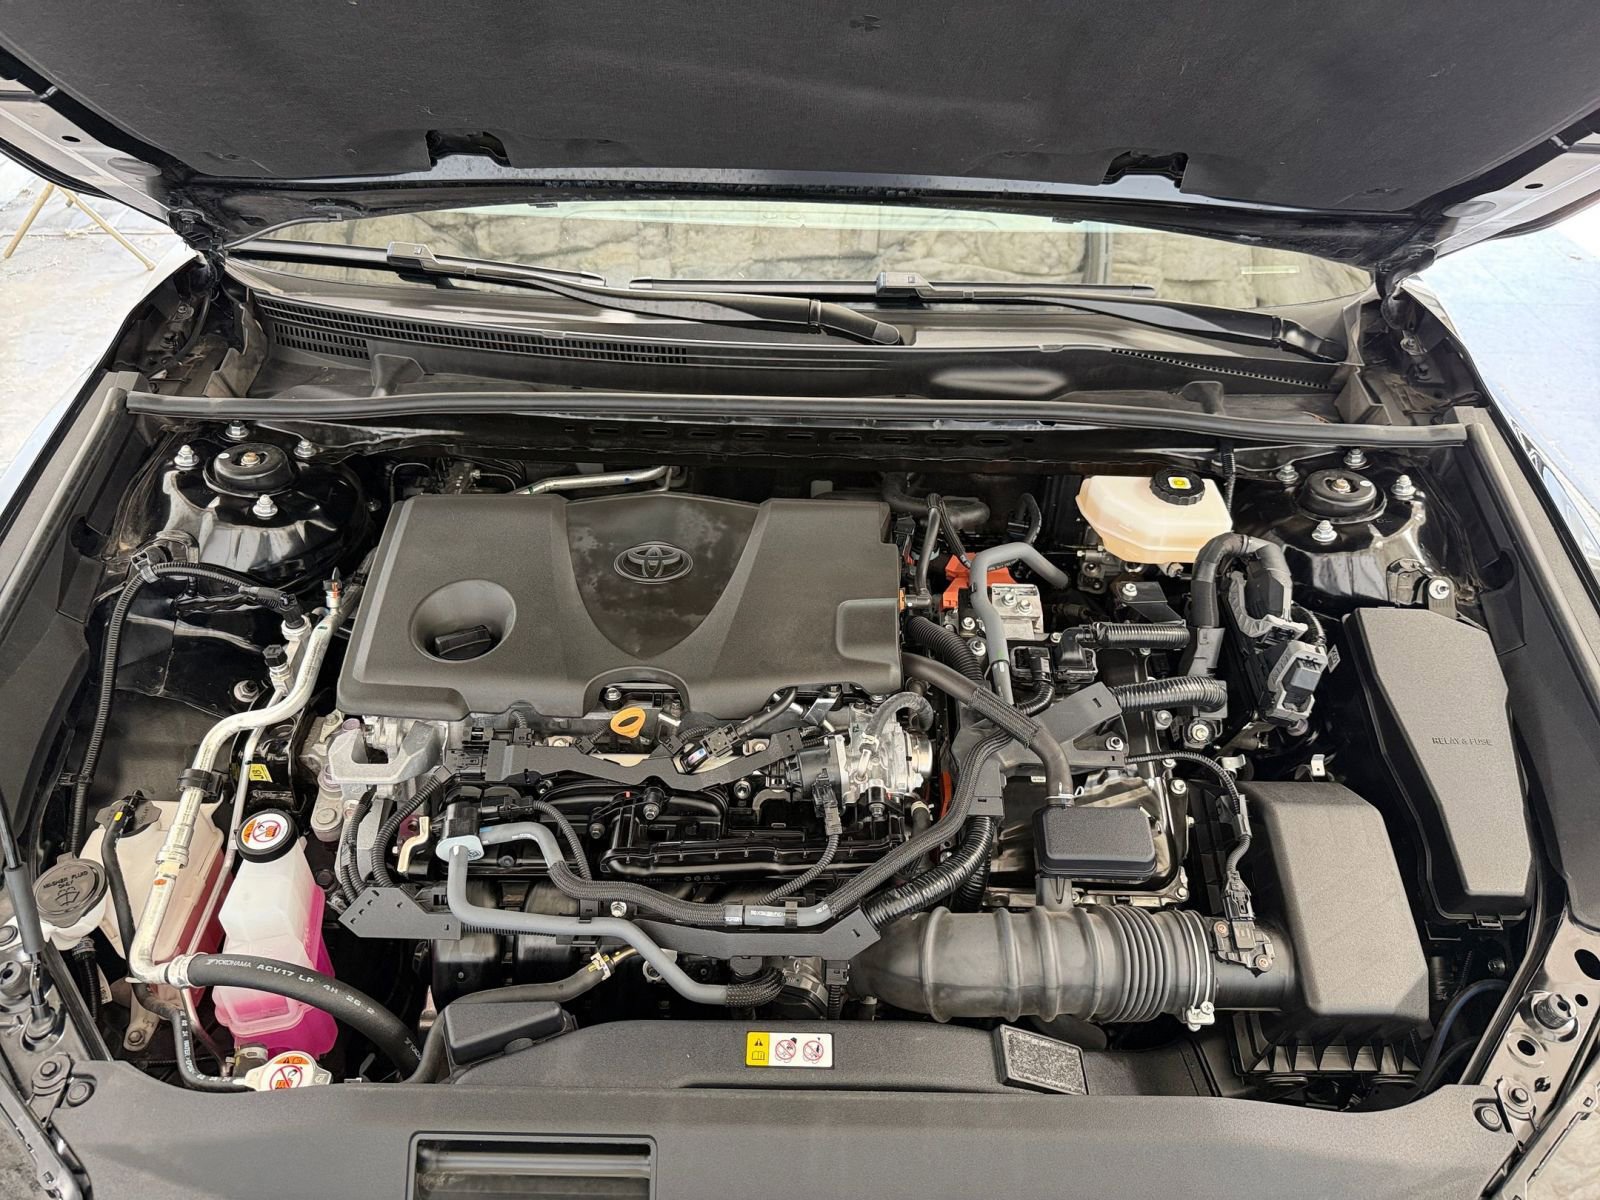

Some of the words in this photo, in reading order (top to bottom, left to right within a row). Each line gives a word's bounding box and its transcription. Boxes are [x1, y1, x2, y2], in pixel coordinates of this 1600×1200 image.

[1431, 736, 1460, 745] RELAY
[1469, 738, 1494, 746] FUSE
[215, 959, 252, 968] YOKOHAMA
[256, 963, 295, 977] ACV17
[298, 974, 315, 983] LP
